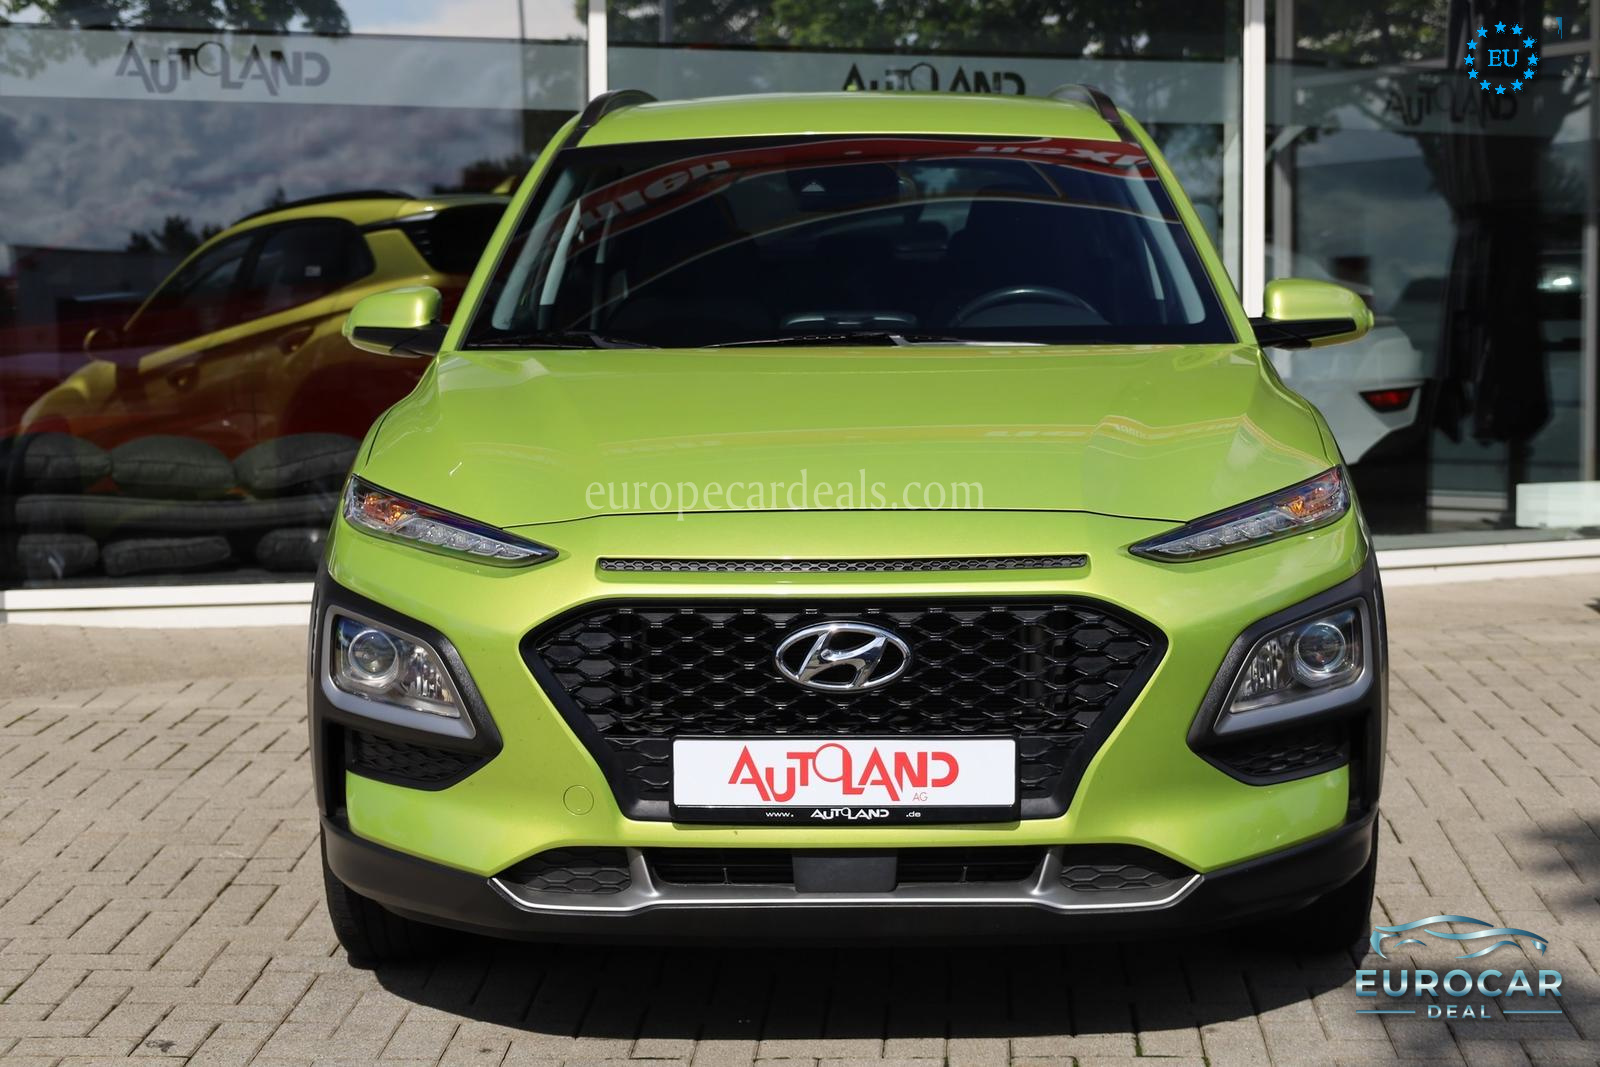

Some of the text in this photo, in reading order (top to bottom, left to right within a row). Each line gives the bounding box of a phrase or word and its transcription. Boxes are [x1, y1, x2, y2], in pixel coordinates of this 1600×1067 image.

[115, 40, 331, 96] AUTOLAND
[727, 742, 960, 803] AUTOLAND
[765, 806, 922, 820] www. AUTOLAND .de
[911, 791, 929, 802] AG
